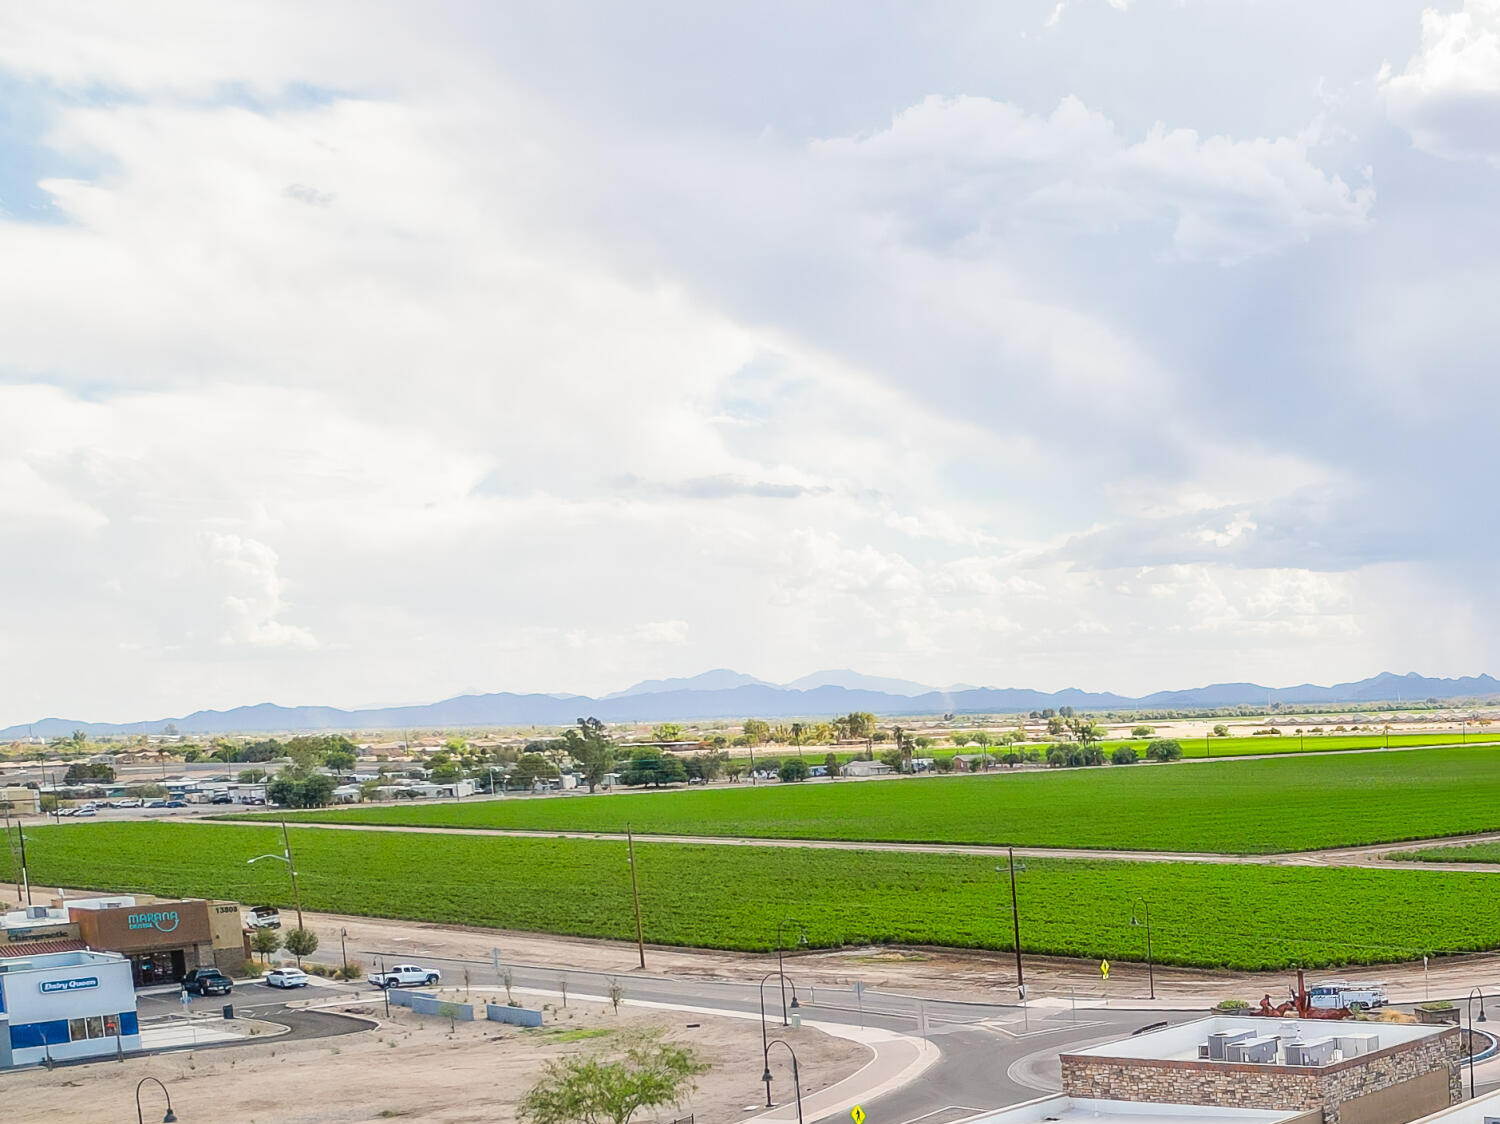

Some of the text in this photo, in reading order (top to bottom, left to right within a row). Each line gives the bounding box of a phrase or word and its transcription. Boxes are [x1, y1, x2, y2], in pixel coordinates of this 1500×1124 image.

[128, 911, 179, 925] MARANA
[44, 980, 96, 991] Dairy Queen
